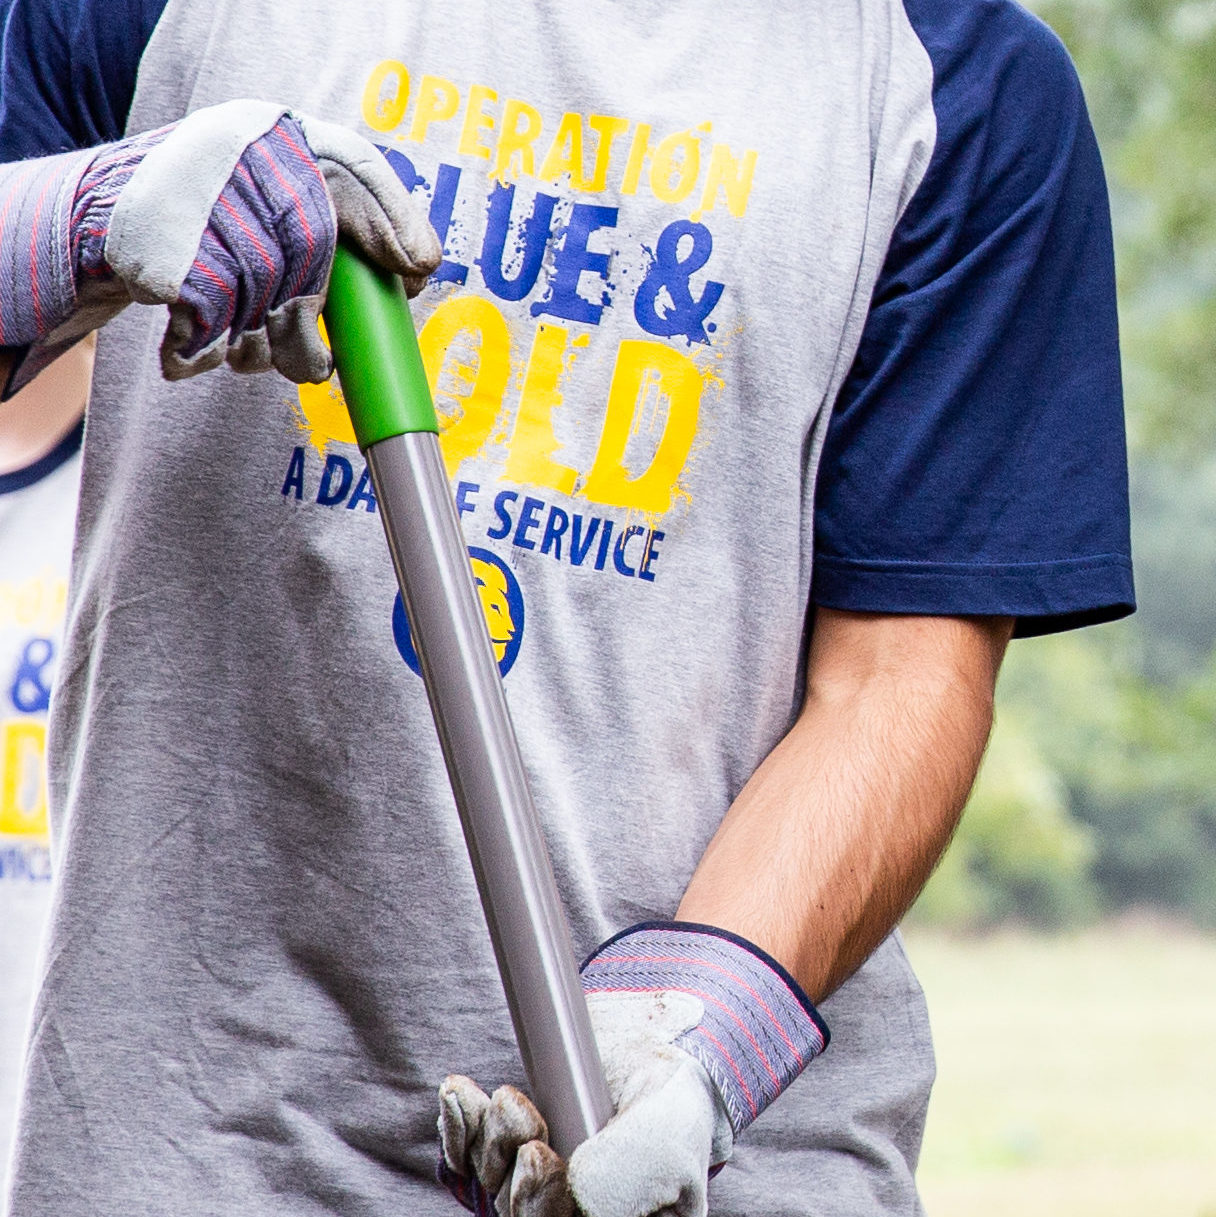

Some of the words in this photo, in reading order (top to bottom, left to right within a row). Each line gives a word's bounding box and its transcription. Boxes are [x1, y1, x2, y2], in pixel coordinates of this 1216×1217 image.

[361, 59, 758, 217] OPERATION
[373, 143, 619, 326] LUE
[633, 219, 725, 345] &
[281, 446, 304, 501] A
[316, 453, 377, 514] DA
[486, 490, 666, 583] SERVICE
